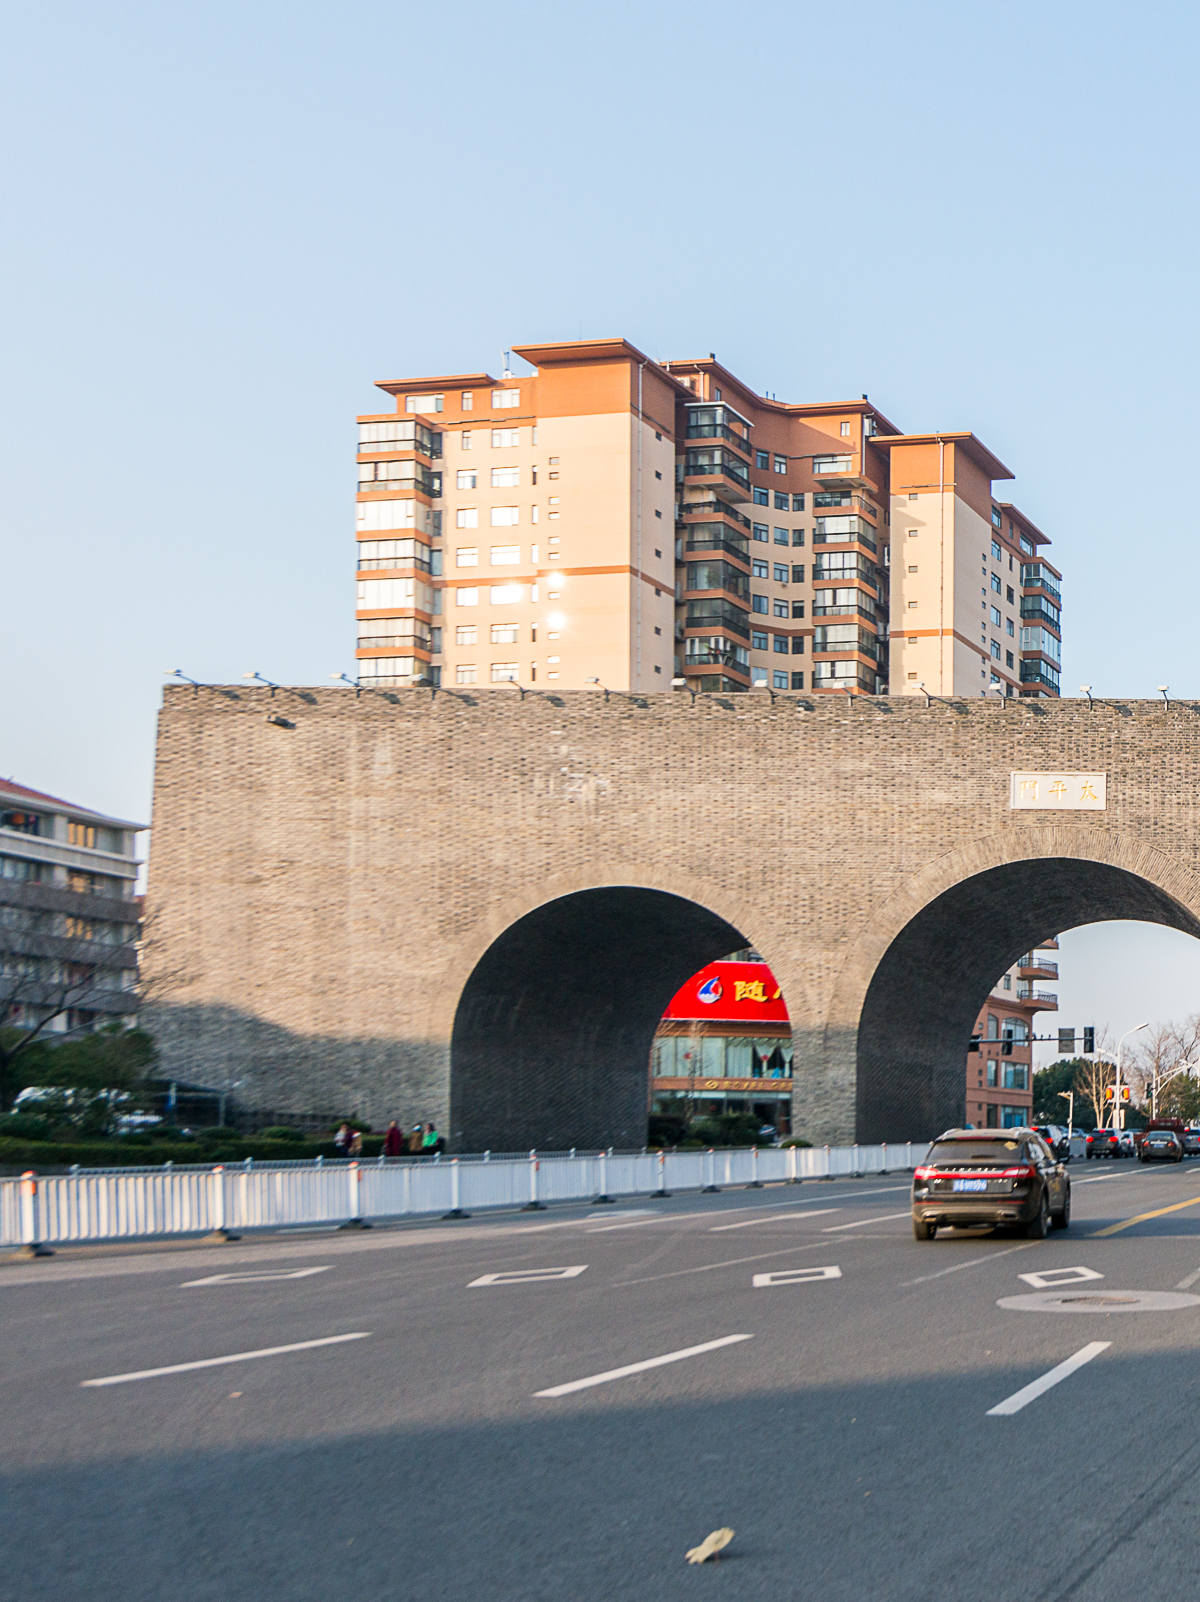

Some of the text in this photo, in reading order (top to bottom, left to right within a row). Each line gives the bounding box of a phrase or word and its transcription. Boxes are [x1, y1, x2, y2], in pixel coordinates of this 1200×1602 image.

[1019, 780, 1099, 802] 太平門
[733, 980, 781, 1003] 随
